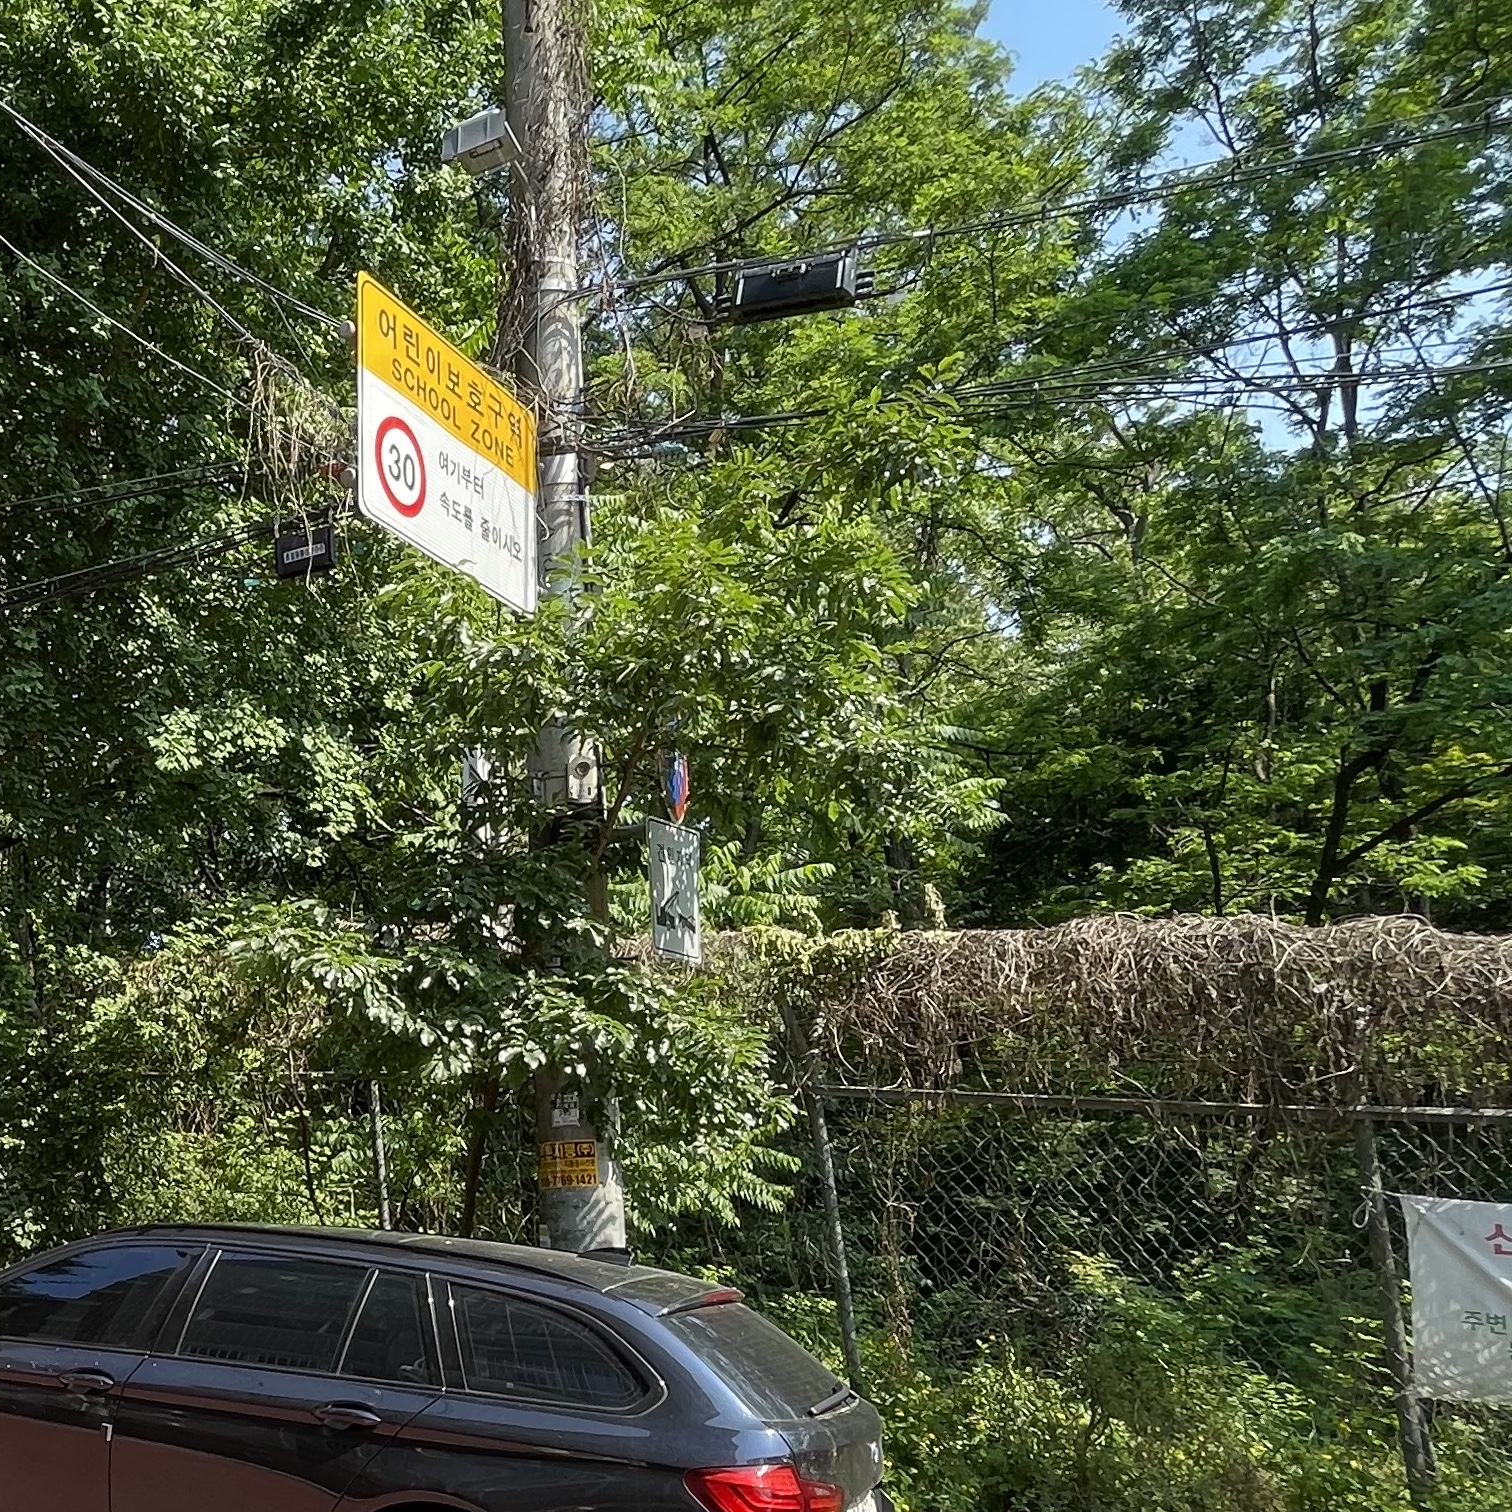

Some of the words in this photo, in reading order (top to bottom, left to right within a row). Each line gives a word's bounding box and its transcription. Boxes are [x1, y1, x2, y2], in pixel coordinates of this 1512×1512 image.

[379, 309, 522, 448] 어린이보호구역
[391, 360, 461, 431] SCHOOL
[471, 421, 514, 468] ZONE
[388, 444, 416, 492] 30
[439, 450, 485, 500] 여기부터
[439, 491, 473, 534] 속도를
[480, 515, 523, 564] 줄이시오
[1461, 1310, 1508, 1336] 주변
